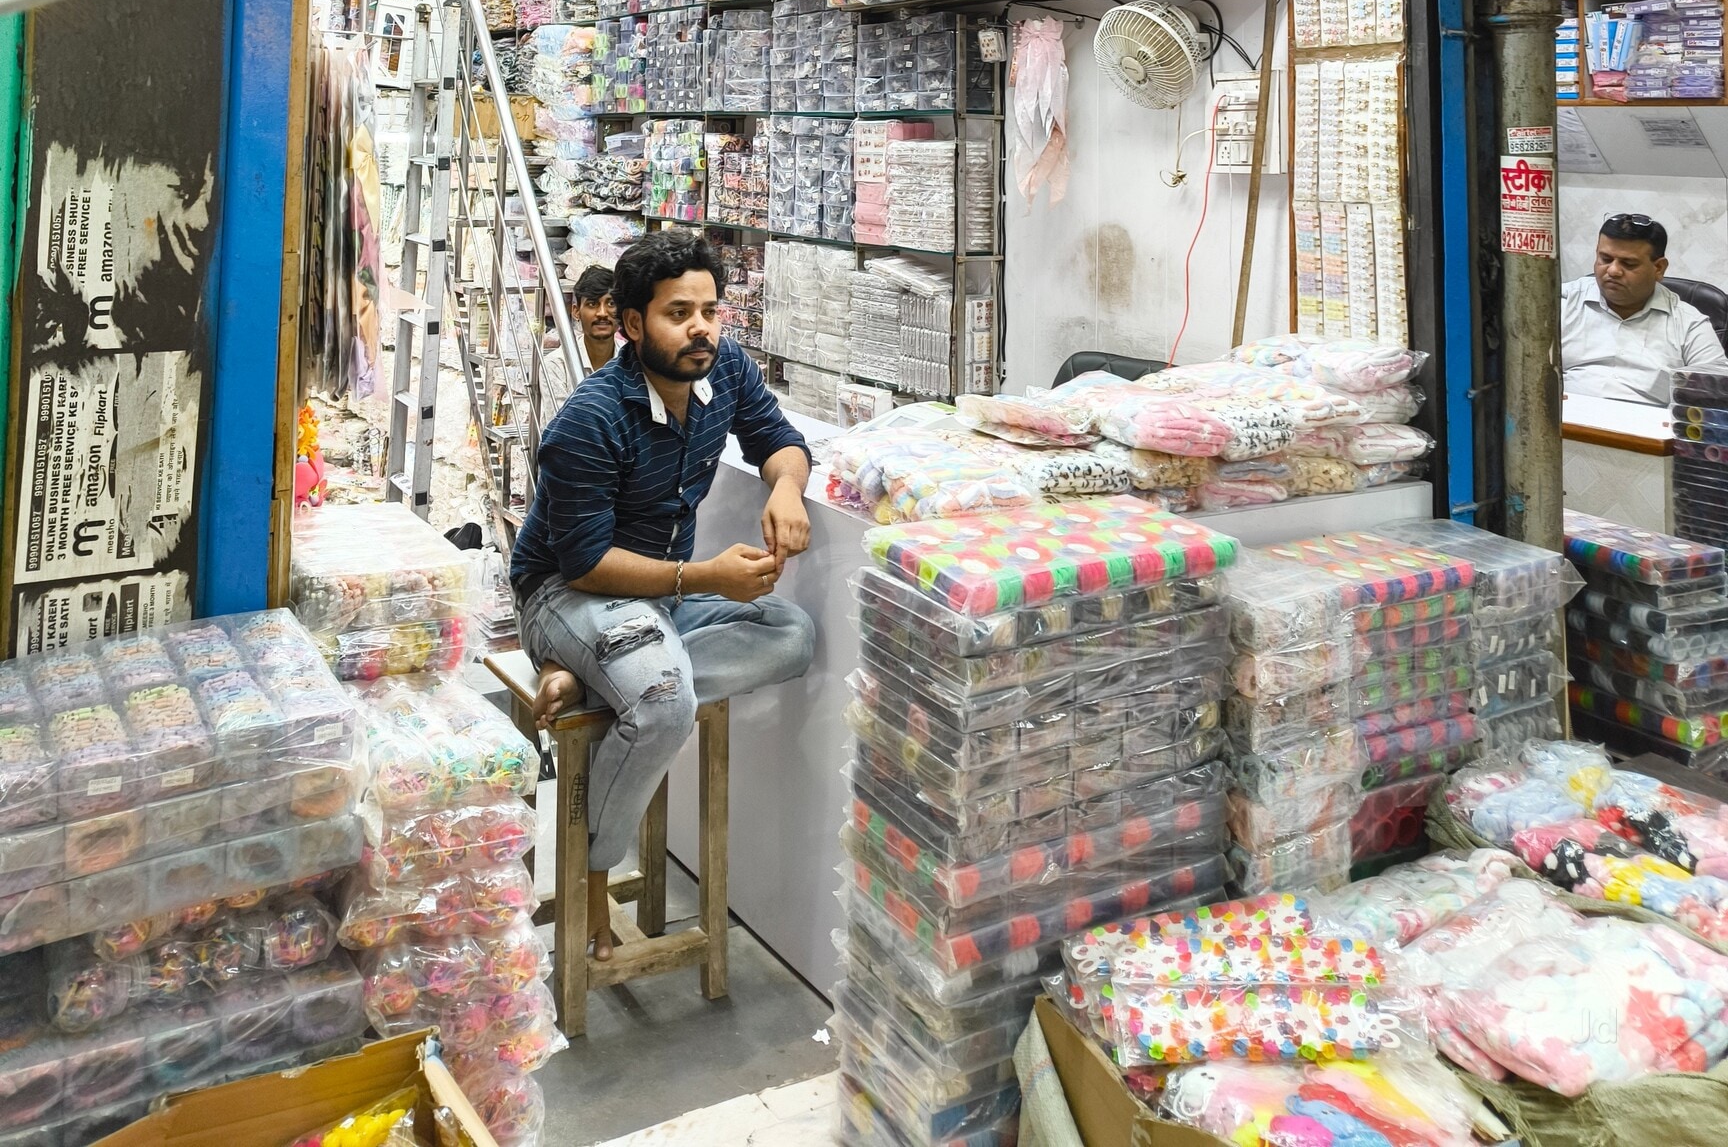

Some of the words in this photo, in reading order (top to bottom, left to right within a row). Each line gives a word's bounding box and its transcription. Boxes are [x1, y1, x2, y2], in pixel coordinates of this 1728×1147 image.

[79, 196, 91, 245] SERVICE
[77, 248, 88, 277] FREE
[68, 401, 78, 417] KE
[93, 389, 108, 436] Flipkart
[53, 411, 65, 452] SHURU
[64, 420, 76, 470] SERVICE
[34, 438, 47, 497] 9990151057
[48, 454, 61, 514] BUSINESS
[61, 474, 72, 503] FREE
[85, 444, 102, 507] amazon
[29, 511, 41, 569] 9990151057
[45, 517, 57, 561] ONLINE
[58, 507, 70, 550] MONTH
[105, 518, 115, 553] meesho
[46, 598, 58, 640] KAREN
[60, 597, 70, 628] SATH
[59, 632, 68, 647] KE
